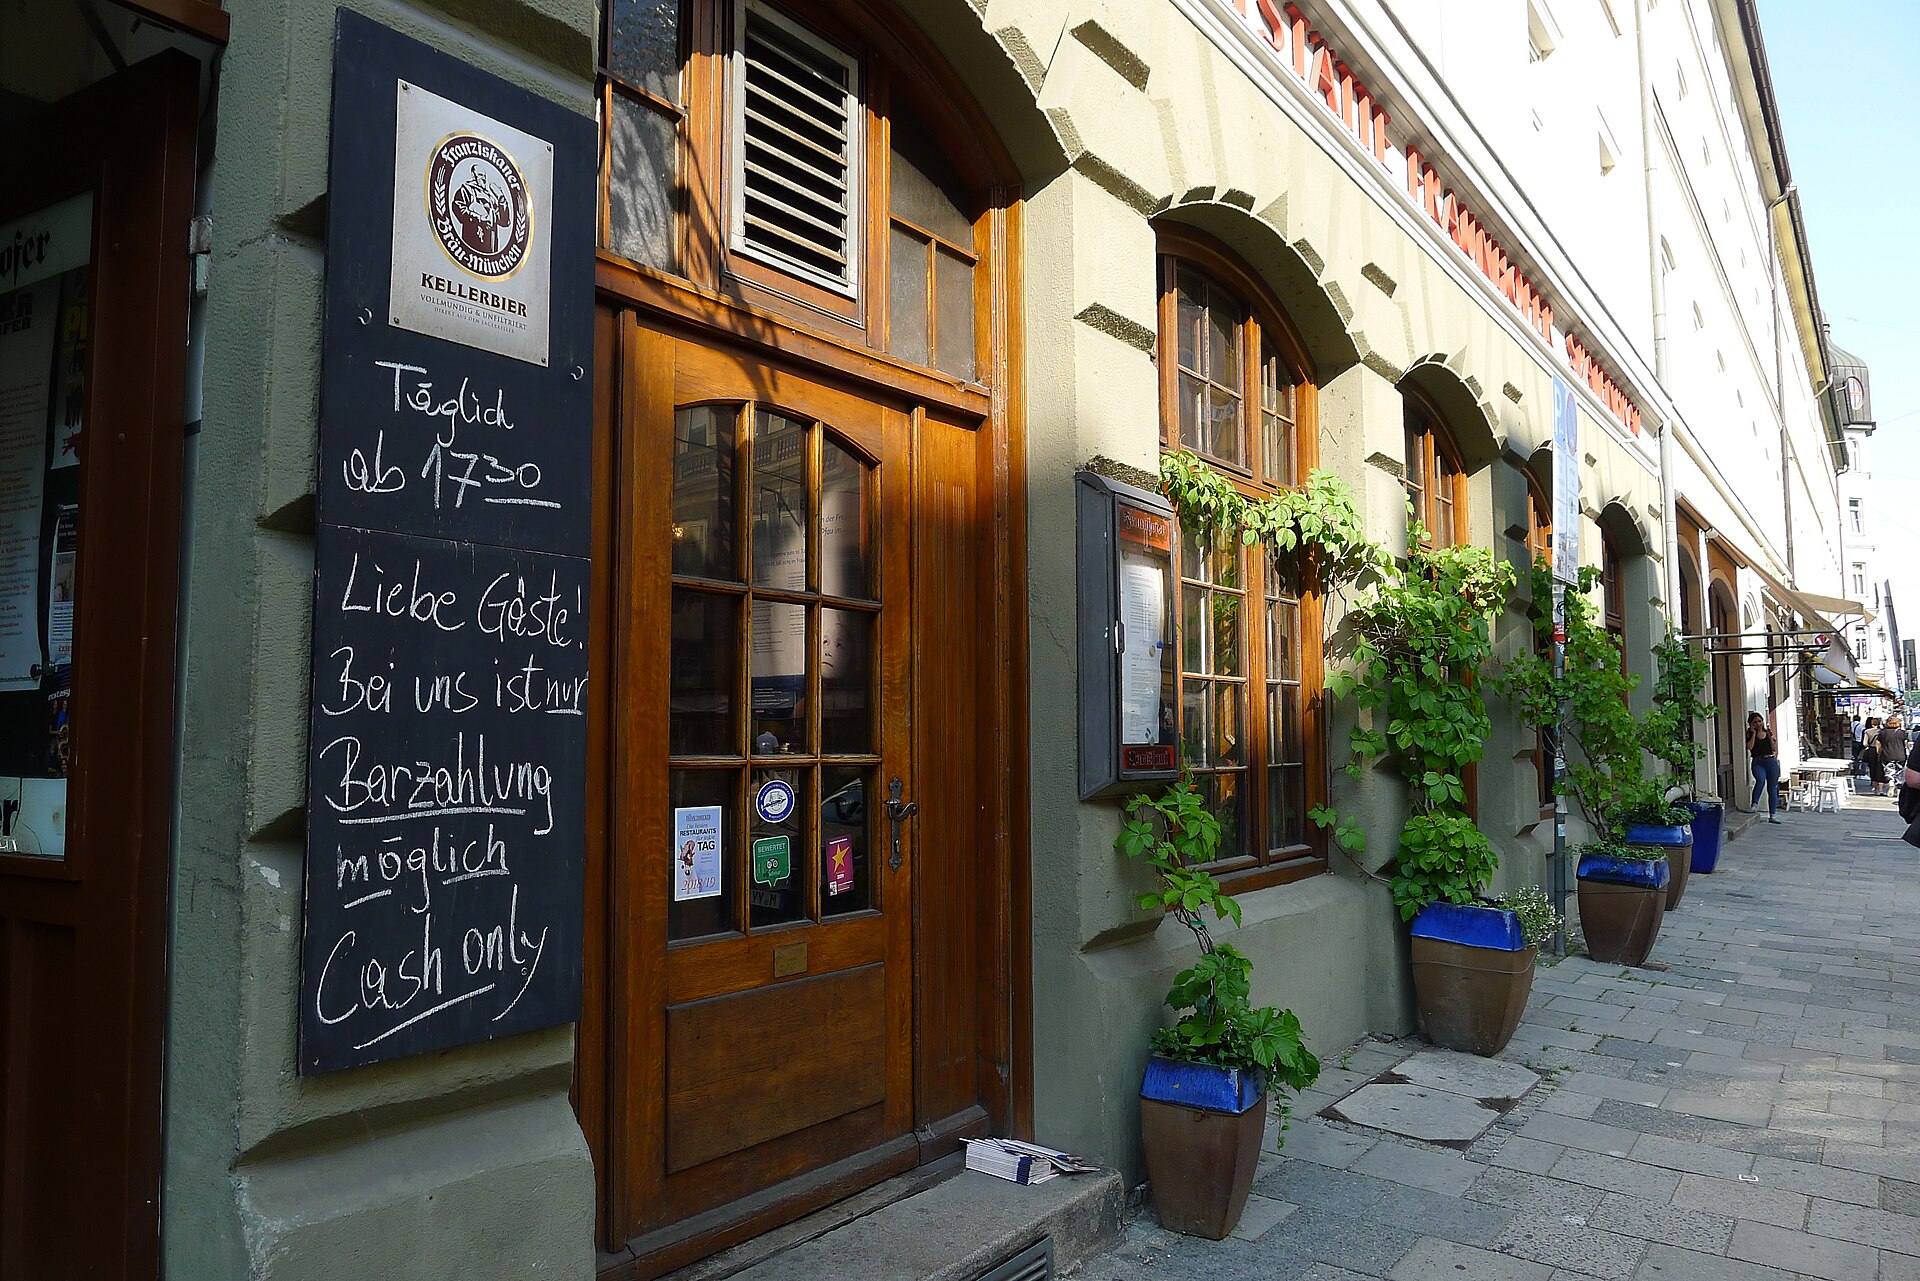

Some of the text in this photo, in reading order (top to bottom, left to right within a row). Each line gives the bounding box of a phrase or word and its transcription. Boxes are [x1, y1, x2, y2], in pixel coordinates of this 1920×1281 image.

[441, 140, 521, 193] Franziskaner
[436, 215, 522, 276] Bräu-München
[420, 272, 529, 319] KELLERBIER
[420, 292, 474, 316] VOLLMUNDIG
[482, 311, 529, 332] UNFILTRIERT
[342, 429, 406, 494] ab
[341, 551, 466, 632] Liebe
[320, 646, 588, 716] Bei uns ist nur
[319, 731, 554, 836] Barzahlung
[679, 828, 717, 837] RESTAURANTS
[697, 840, 716, 852] TAG
[757, 842, 786, 854] BEWERTET
[336, 824, 511, 914] möglich
[314, 883, 550, 1026] Cash only
